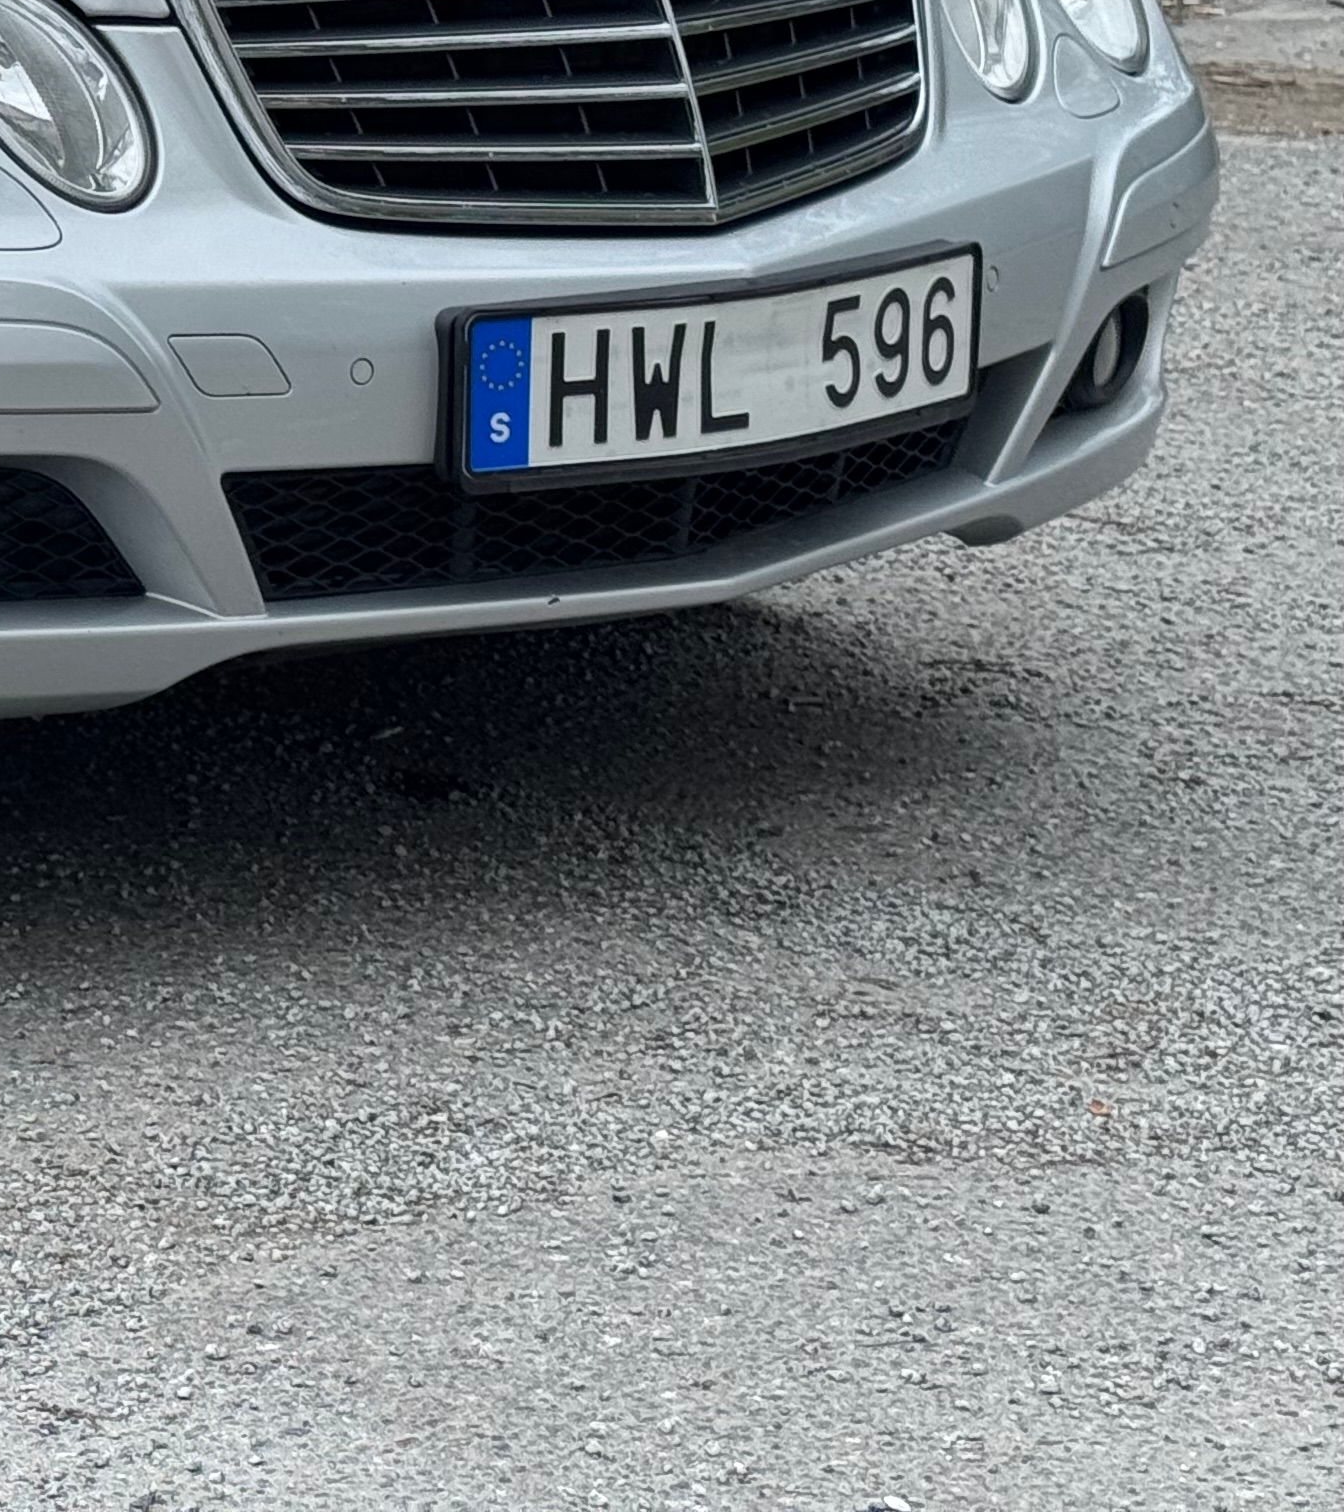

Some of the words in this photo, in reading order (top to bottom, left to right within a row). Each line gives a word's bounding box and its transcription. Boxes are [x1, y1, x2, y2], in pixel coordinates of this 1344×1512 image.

[548, 321, 749, 448] HWL
[821, 276, 956, 408] 596
[489, 411, 511, 444] S
